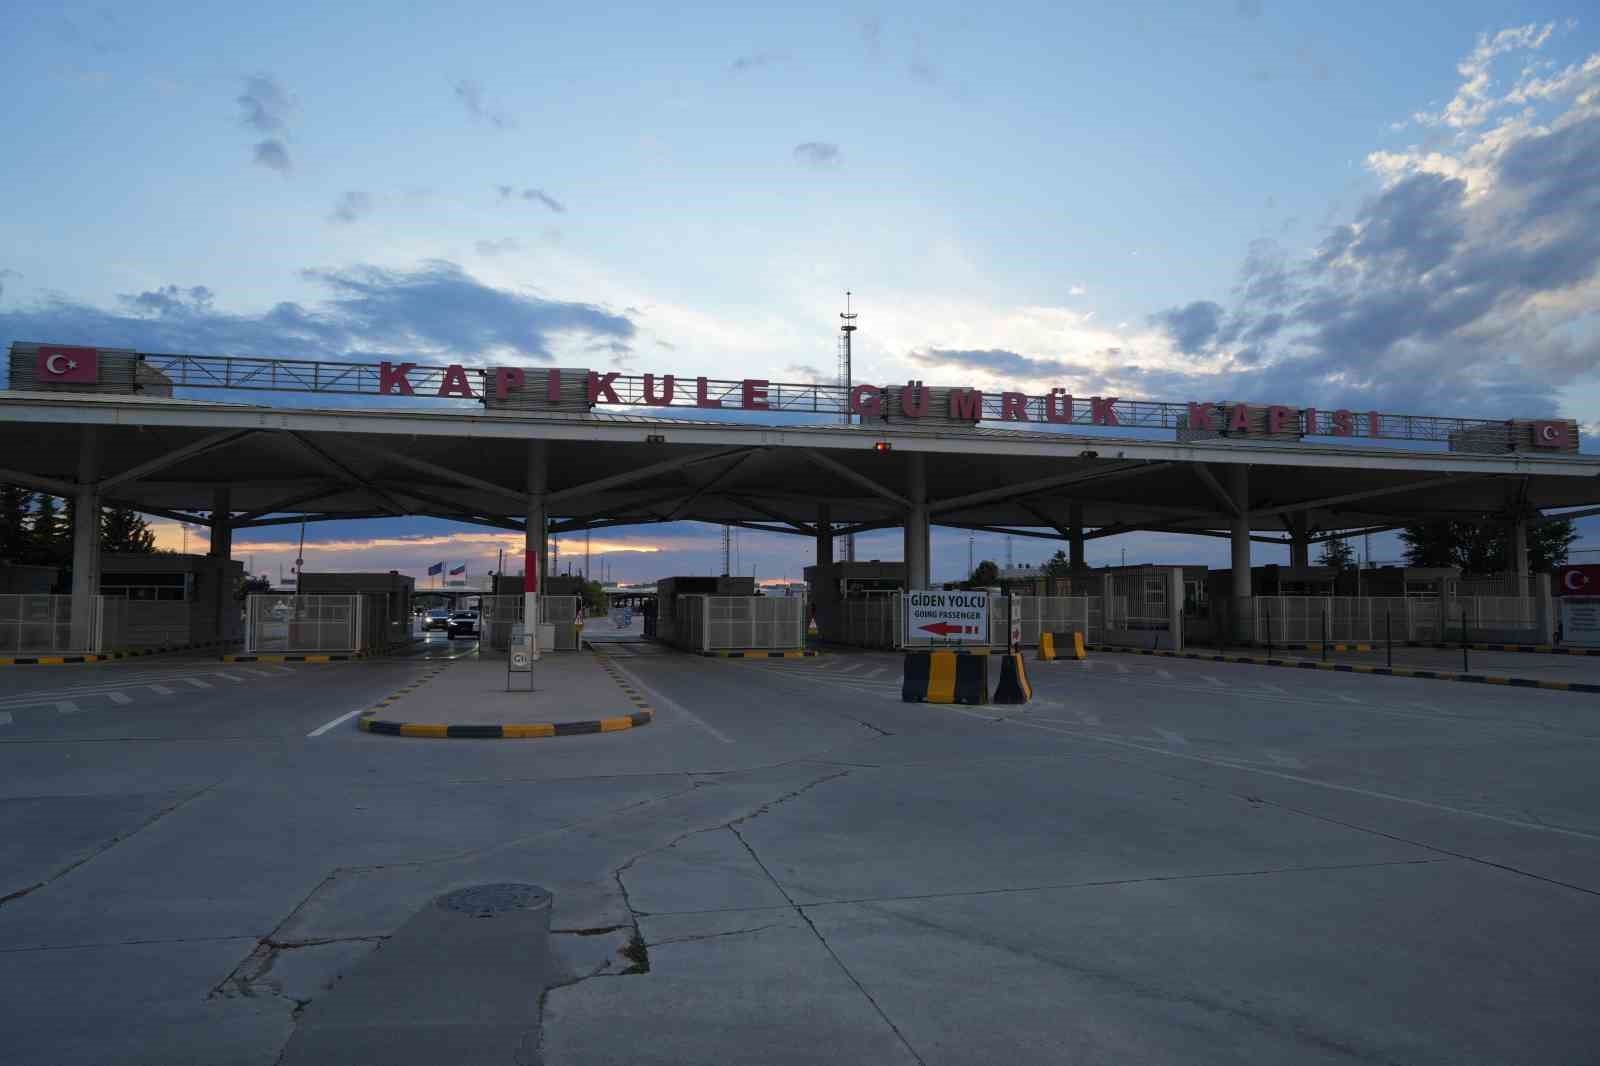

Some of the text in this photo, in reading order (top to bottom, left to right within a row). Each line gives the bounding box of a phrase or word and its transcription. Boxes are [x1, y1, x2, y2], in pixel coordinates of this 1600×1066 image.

[379, 361, 1380, 436] KAPIKULE GÜMRÜK KAPISI
[911, 593, 985, 608] GİDEN YOLCU
[914, 610, 981, 620] GOING PASSENGER
